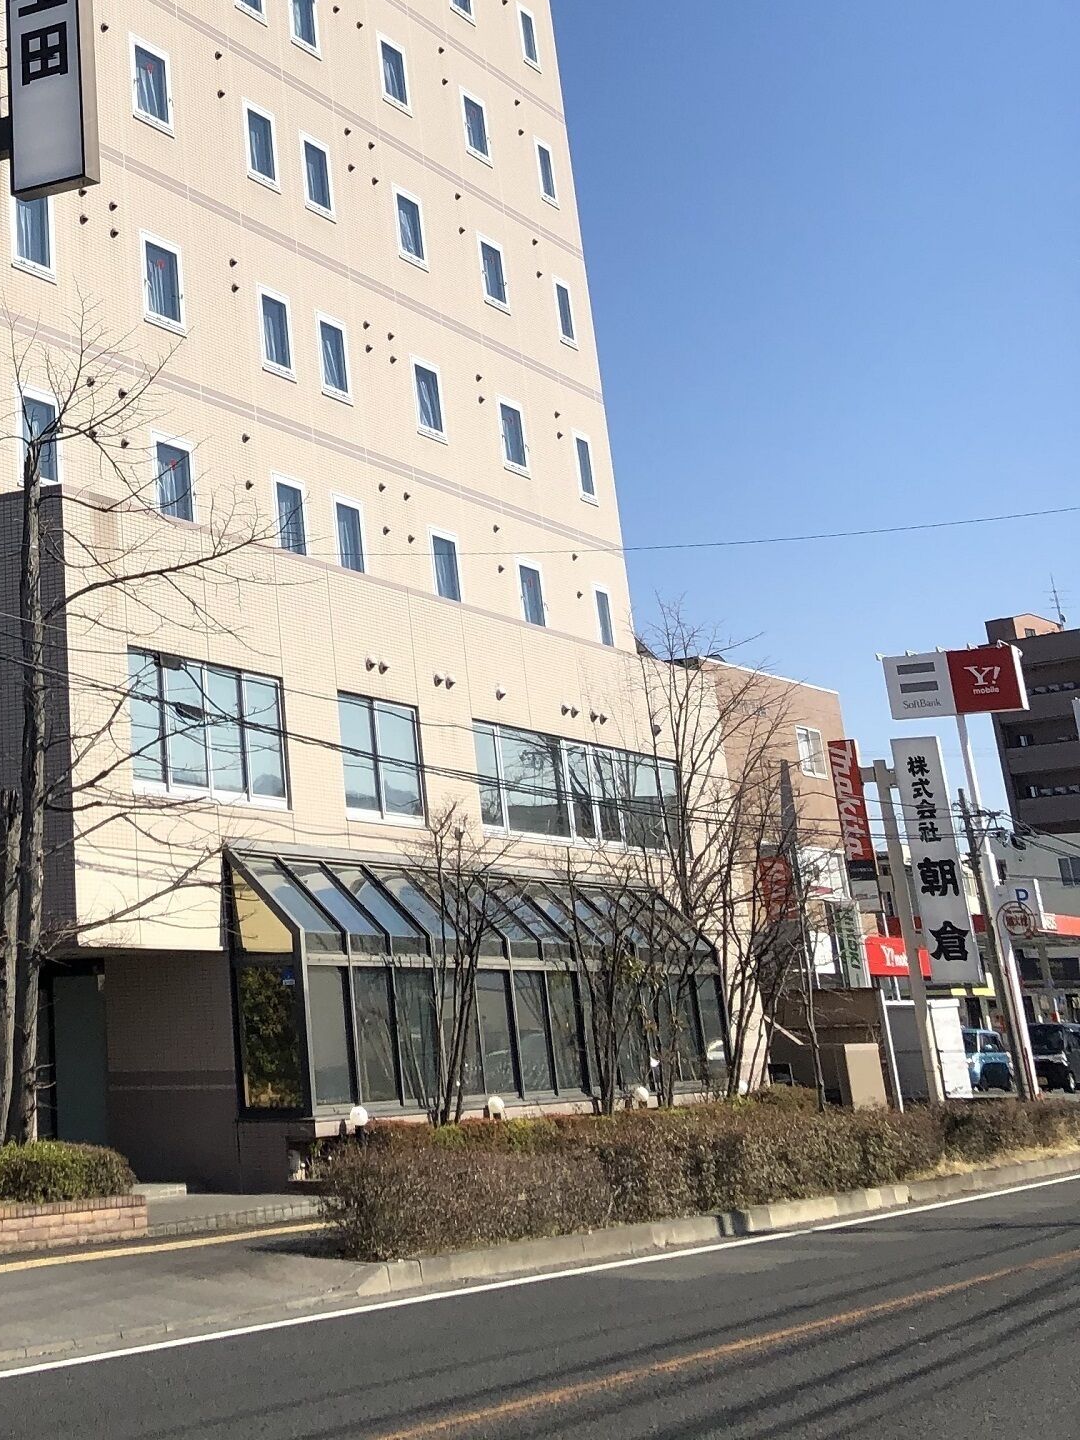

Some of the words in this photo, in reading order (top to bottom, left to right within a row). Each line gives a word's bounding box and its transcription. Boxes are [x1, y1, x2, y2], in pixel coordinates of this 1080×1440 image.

[963, 666, 1001, 686] Y!
[972, 686, 1000, 695] mobile
[903, 697, 942, 710] SoftBank
[906, 755, 942, 843] 株式会社
[917, 857, 969, 962] 朝倉
